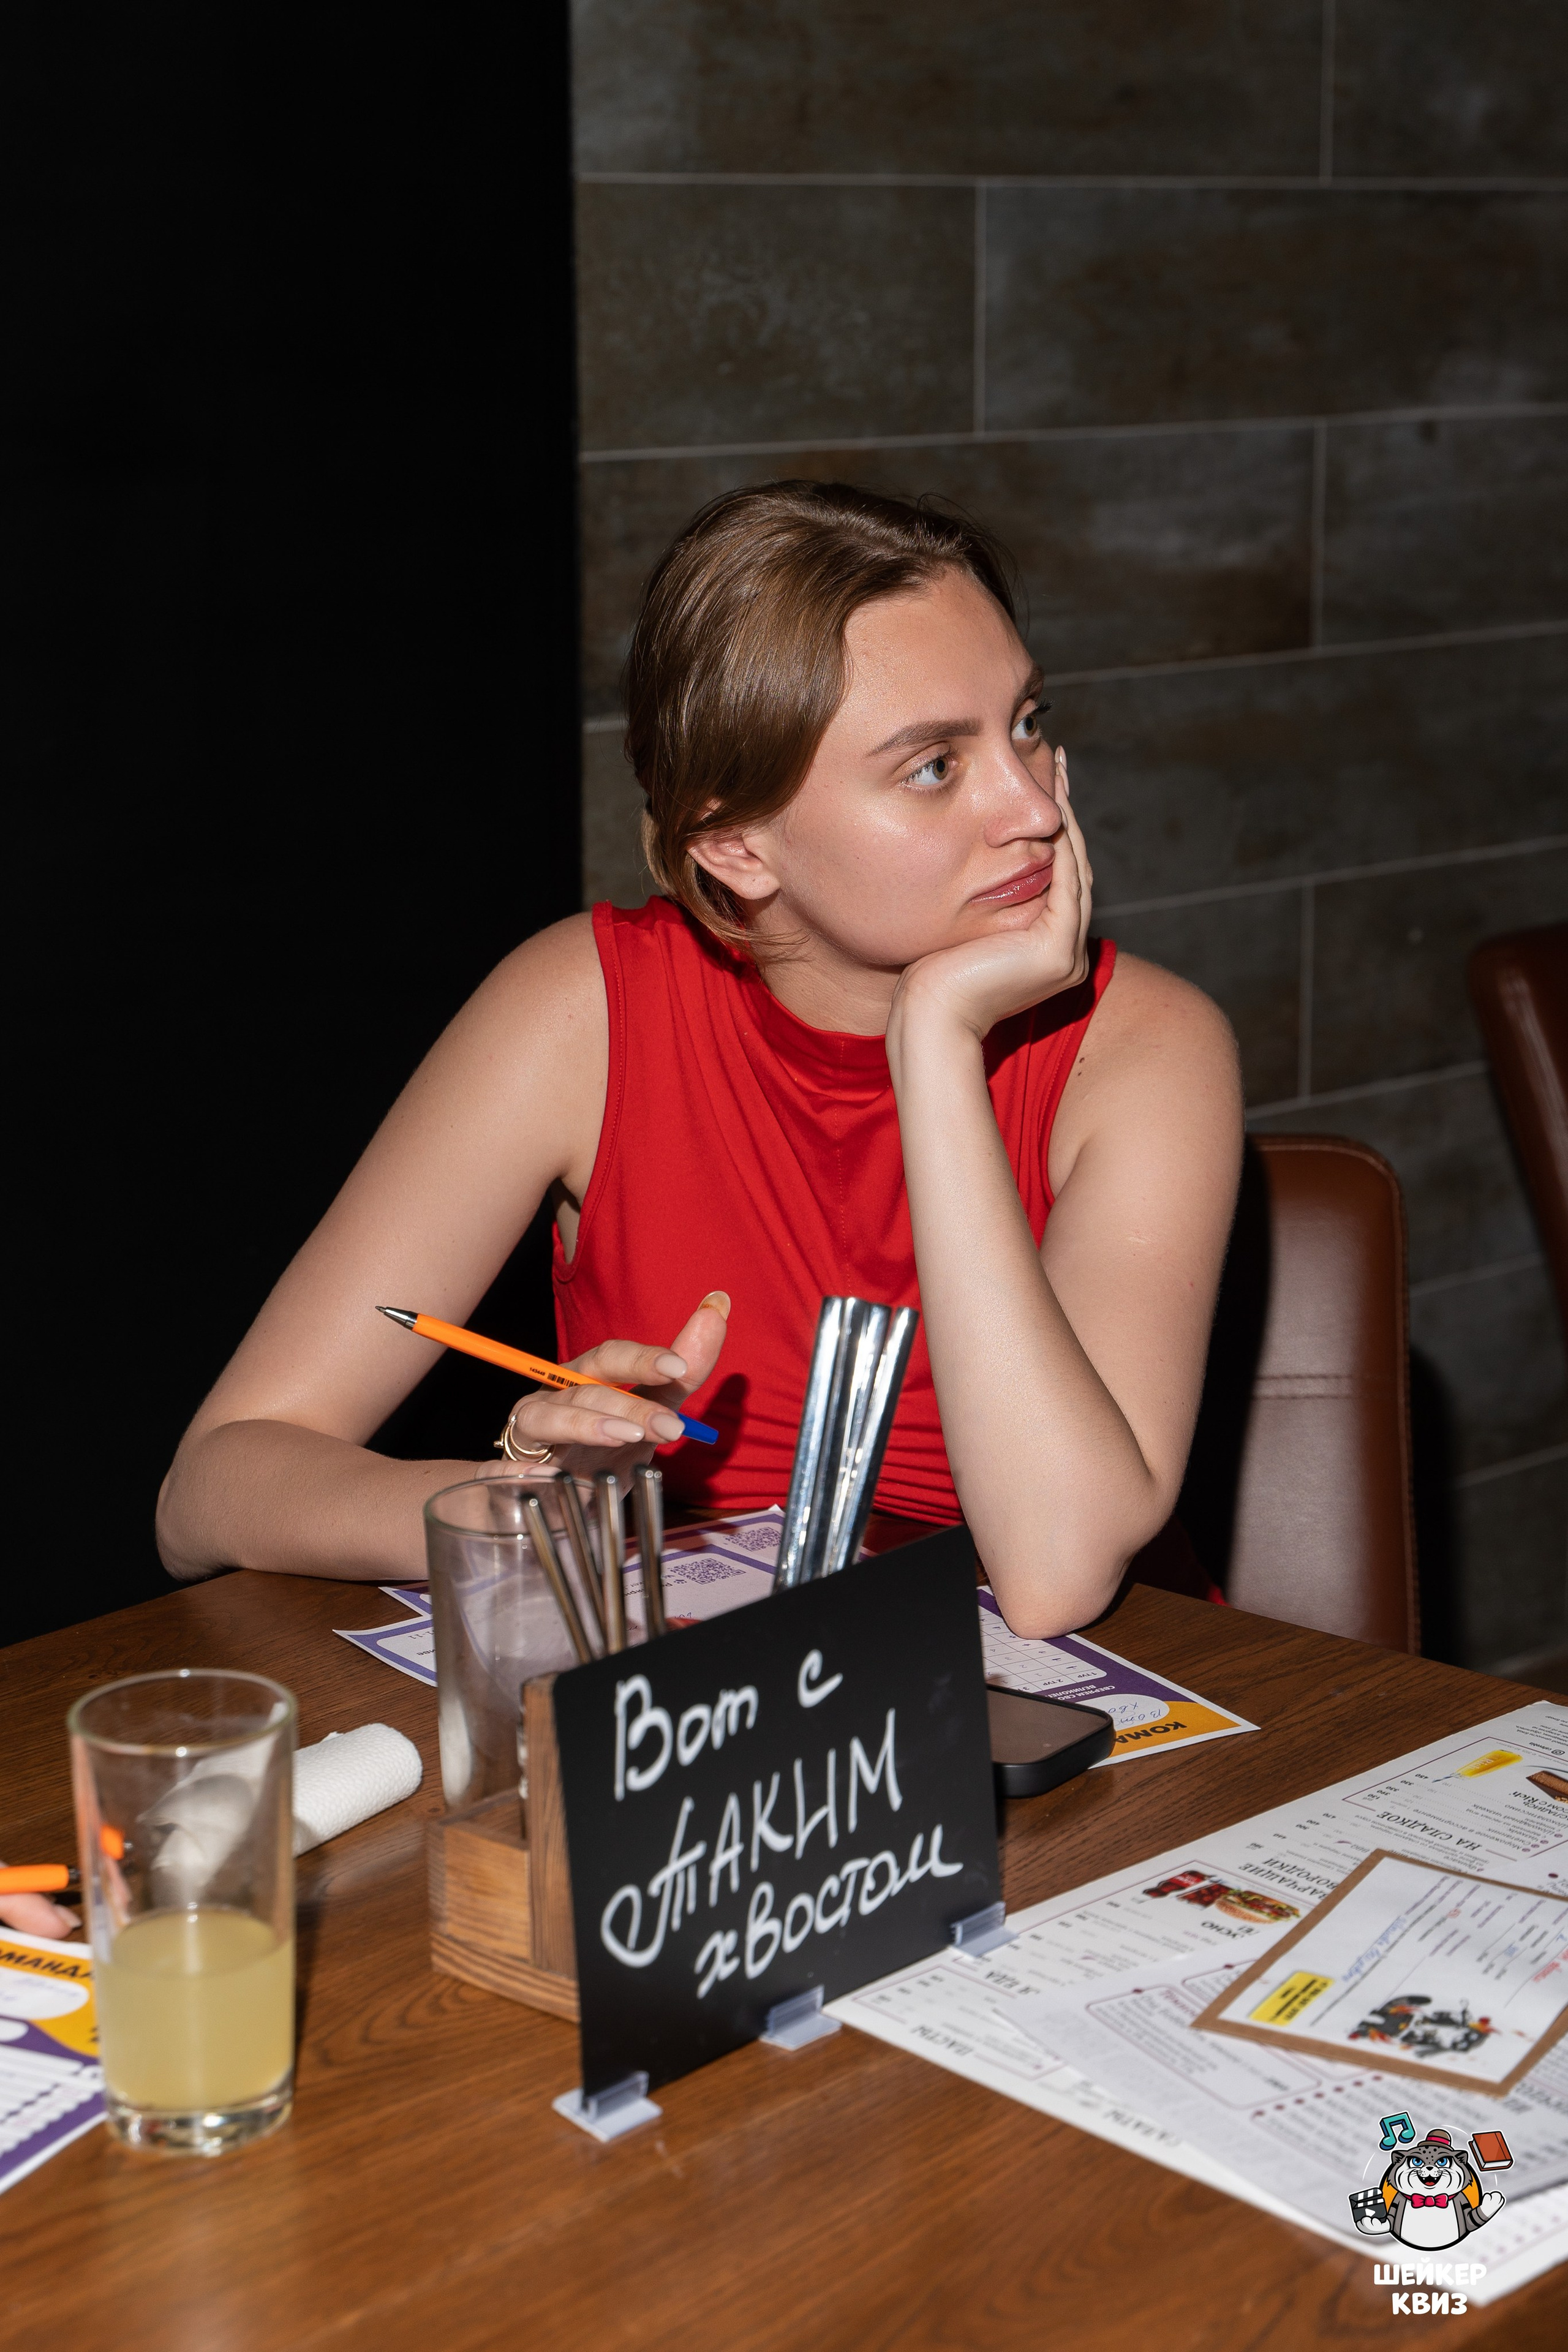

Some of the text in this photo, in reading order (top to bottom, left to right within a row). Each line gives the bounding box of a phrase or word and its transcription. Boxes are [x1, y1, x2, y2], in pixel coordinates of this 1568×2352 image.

[1057, 1684, 1115, 1702] СВЕРЯЕМ СВО
[614, 1673, 759, 1801] Вот
[1115, 1721, 1187, 1743] КОМА
[1413, 1809, 1468, 1830] ассортименте
[1471, 1804, 1502, 1817] чизкейк
[1376, 1812, 1482, 1850] НА СЛАДКОЕ
[1502, 1815, 1555, 1835] Шоколадный
[1509, 1828, 1539, 1842] Чизкейк
[600, 1708, 903, 1968] ТАКИМ
[1475, 1831, 1523, 1850] Мороженое
[1487, 1828, 1533, 1845] Сметанник
[1238, 1863, 1327, 1899] ВАРЧАЩИЕ
